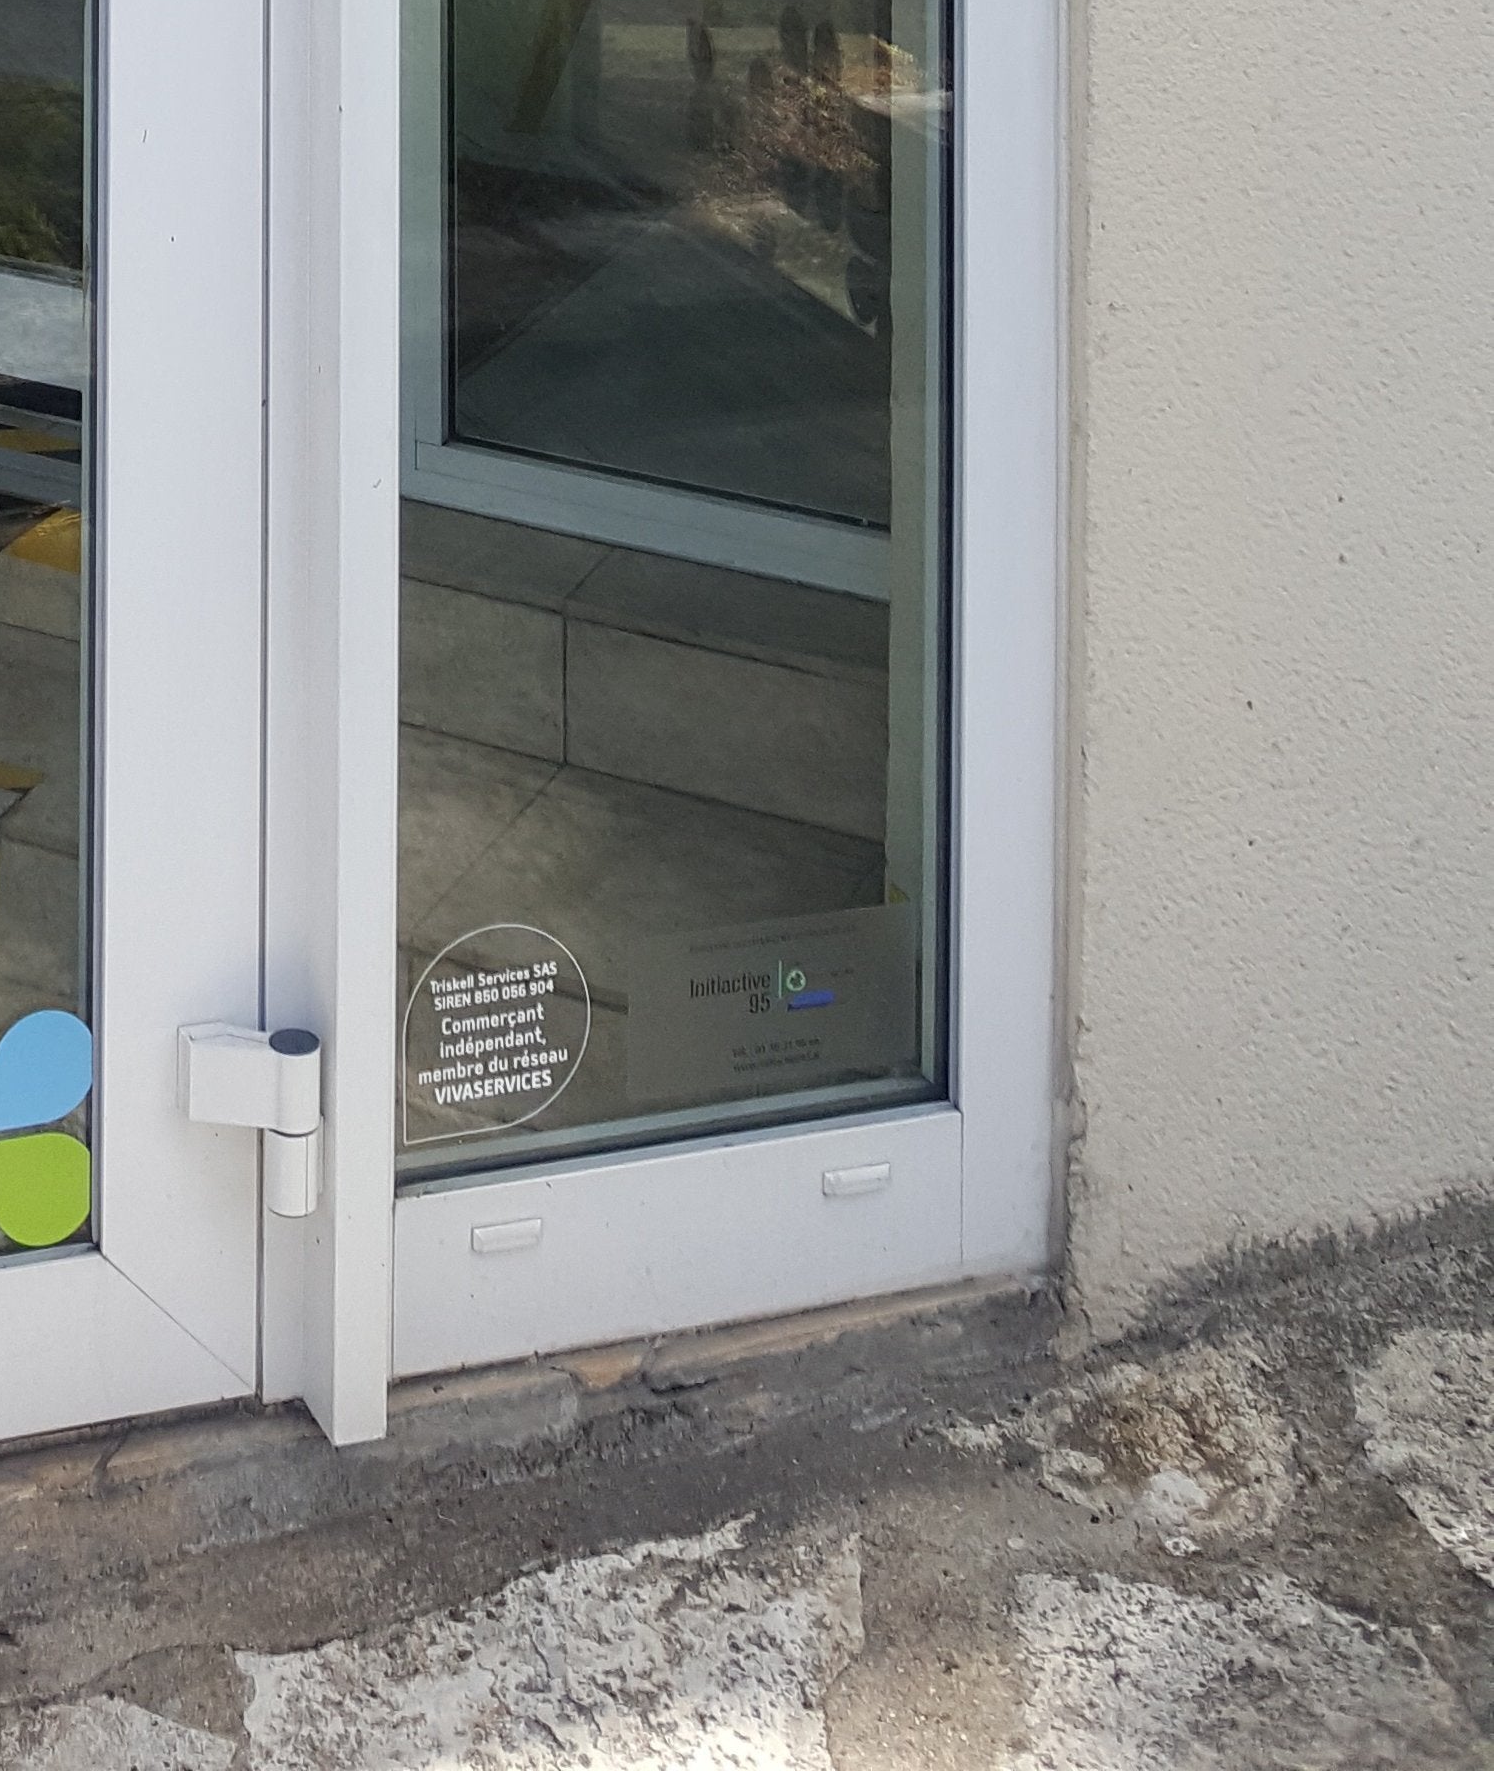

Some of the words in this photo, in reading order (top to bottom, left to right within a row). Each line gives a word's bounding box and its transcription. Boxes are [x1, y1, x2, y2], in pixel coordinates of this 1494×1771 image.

[430, 974, 475, 994] Triskell
[477, 967, 531, 987] Services
[533, 961, 558, 978] SAS
[690, 971, 771, 998] Initiactive
[434, 992, 471, 1011] SIREN
[529, 979, 555, 995] 904
[749, 993, 771, 1014] 95
[441, 1002, 545, 1036] Commerçant
[439, 1025, 547, 1059] indépendant,
[418, 1061, 484, 1085] membre
[488, 1055, 508, 1073] du
[513, 1048, 569, 1070] réseau
[434, 1069, 553, 1105] VIVASERVICES
